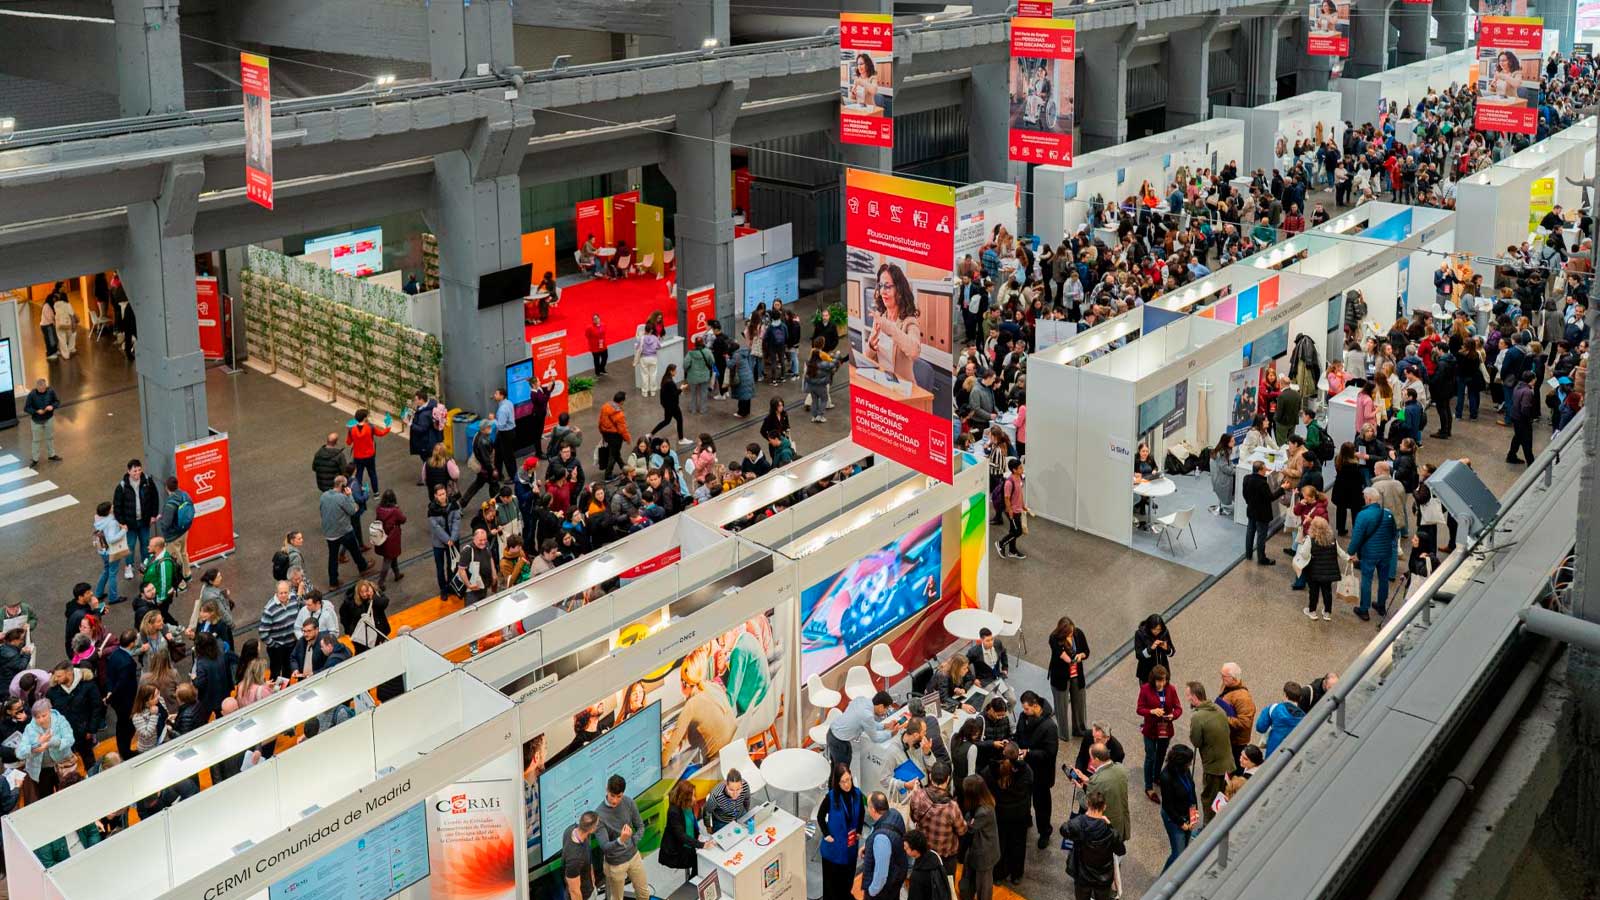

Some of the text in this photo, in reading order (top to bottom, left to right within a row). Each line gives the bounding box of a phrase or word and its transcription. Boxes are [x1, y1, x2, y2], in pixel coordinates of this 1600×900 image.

[866, 228, 931, 251] #buscamostutalento
[855, 396, 909, 424] XVI Feria de Empleo
[866, 410, 903, 431] PERSONAS
[856, 415, 920, 448] CON DISCAPACIDAD
[679, 630, 696, 644] ONCE
[203, 866, 252, 900] CERMI
[255, 818, 340, 874] Comunidad
[343, 808, 362, 826] de
[365, 779, 411, 815] Madrid
